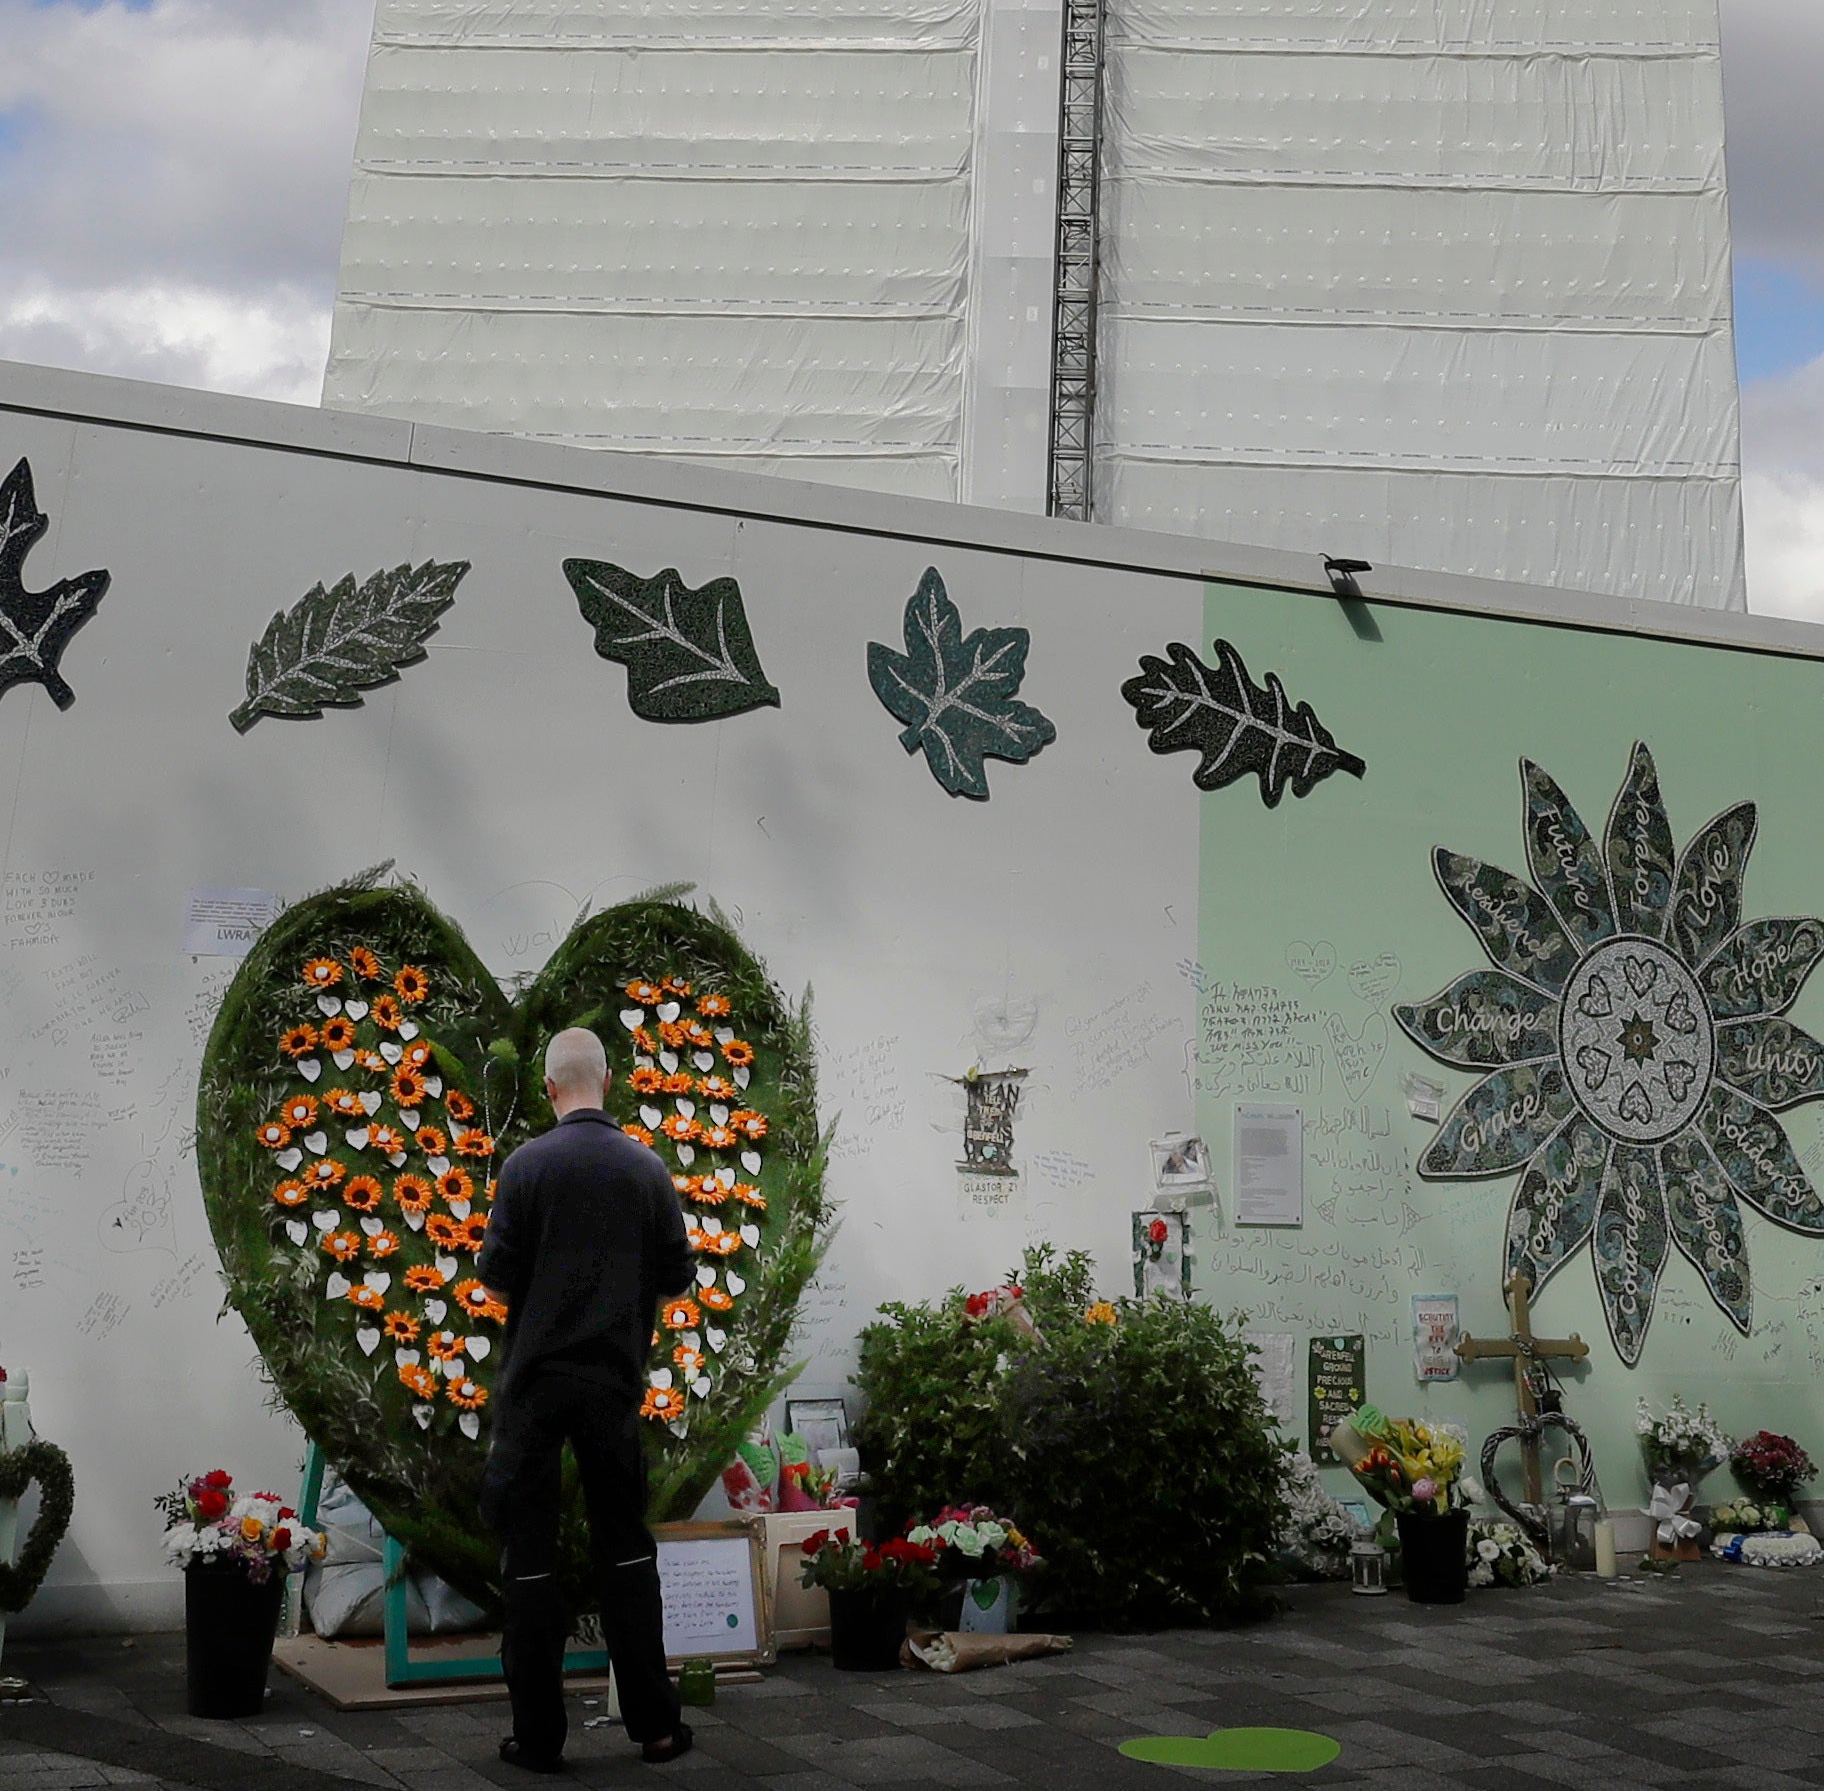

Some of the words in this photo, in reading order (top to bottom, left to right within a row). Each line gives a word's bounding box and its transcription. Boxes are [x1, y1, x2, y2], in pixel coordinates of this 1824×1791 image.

[1533, 801, 1592, 914] Future
[1629, 789, 1658, 915] Forever
[4, 871, 36, 884] EACH
[62, 870, 96, 882] MADE
[5, 887, 32, 898] WITH
[38, 885, 51, 896] SO
[1686, 840, 1731, 927] Love
[5, 898, 34, 911] LOVE
[1729, 942, 1795, 993] Hope
[1434, 1004, 1542, 1044] Change
[1742, 1039, 1822, 1085] Unity
[1458, 1088, 1545, 1154] Grace
[971, 1193, 1010, 1206] RESPECT
[1685, 1166, 1739, 1274] Respect
[1620, 1181, 1644, 1316] Courage
[1431, 1325, 1444, 1333] THE
[1316, 1374, 1354, 1385] PRECIOUS
[1328, 1390, 1344, 1400] AND
